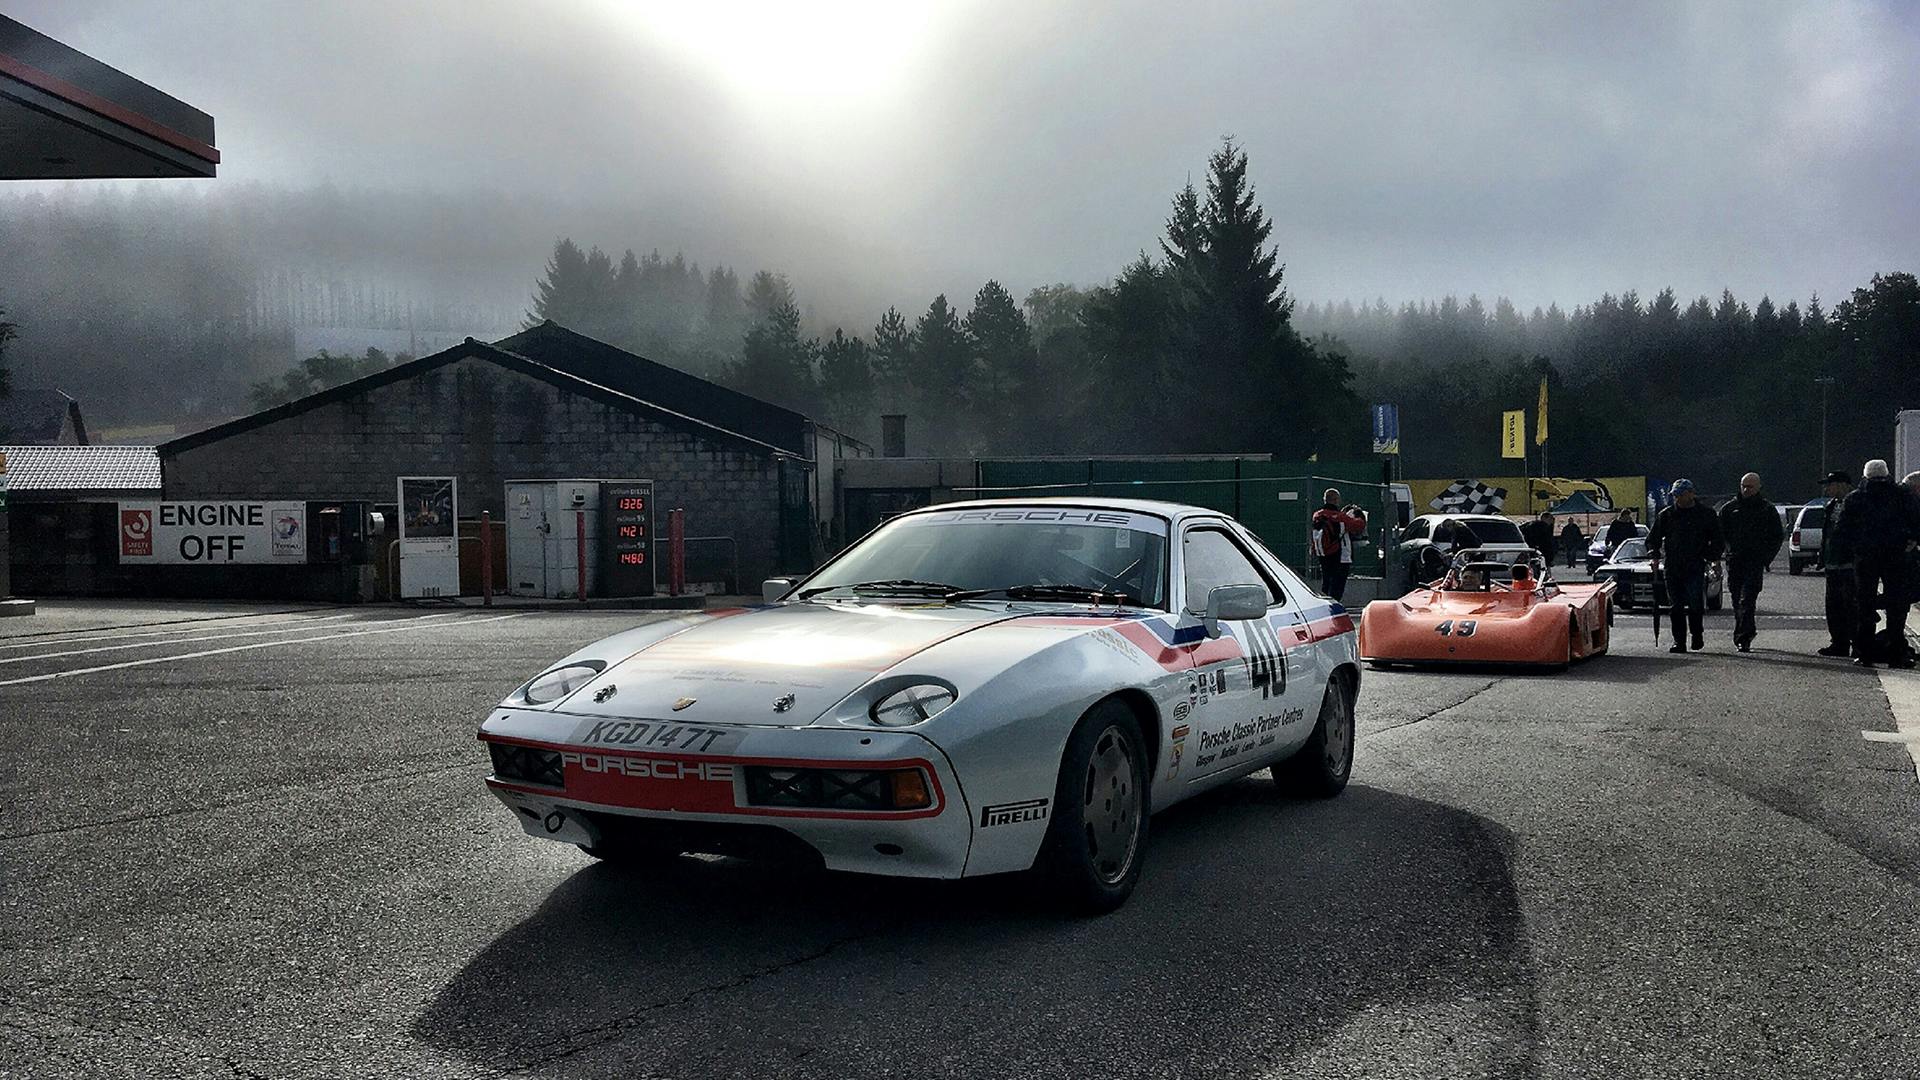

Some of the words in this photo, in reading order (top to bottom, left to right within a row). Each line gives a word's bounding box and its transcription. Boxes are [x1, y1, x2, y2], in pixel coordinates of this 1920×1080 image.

[160, 504, 264, 526] ENGINE
[620, 499, 643, 510] 1326
[620, 526, 643, 537] 1421
[179, 535, 245, 561] OFF
[1435, 620, 1478, 637] 49
[1241, 619, 1286, 700] 40
[1200, 726, 1231, 751] Porsche
[1231, 718, 1256, 742] Classic
[560, 752, 734, 781] PORSCHE
[980, 798, 1049, 828] PIRELLI
